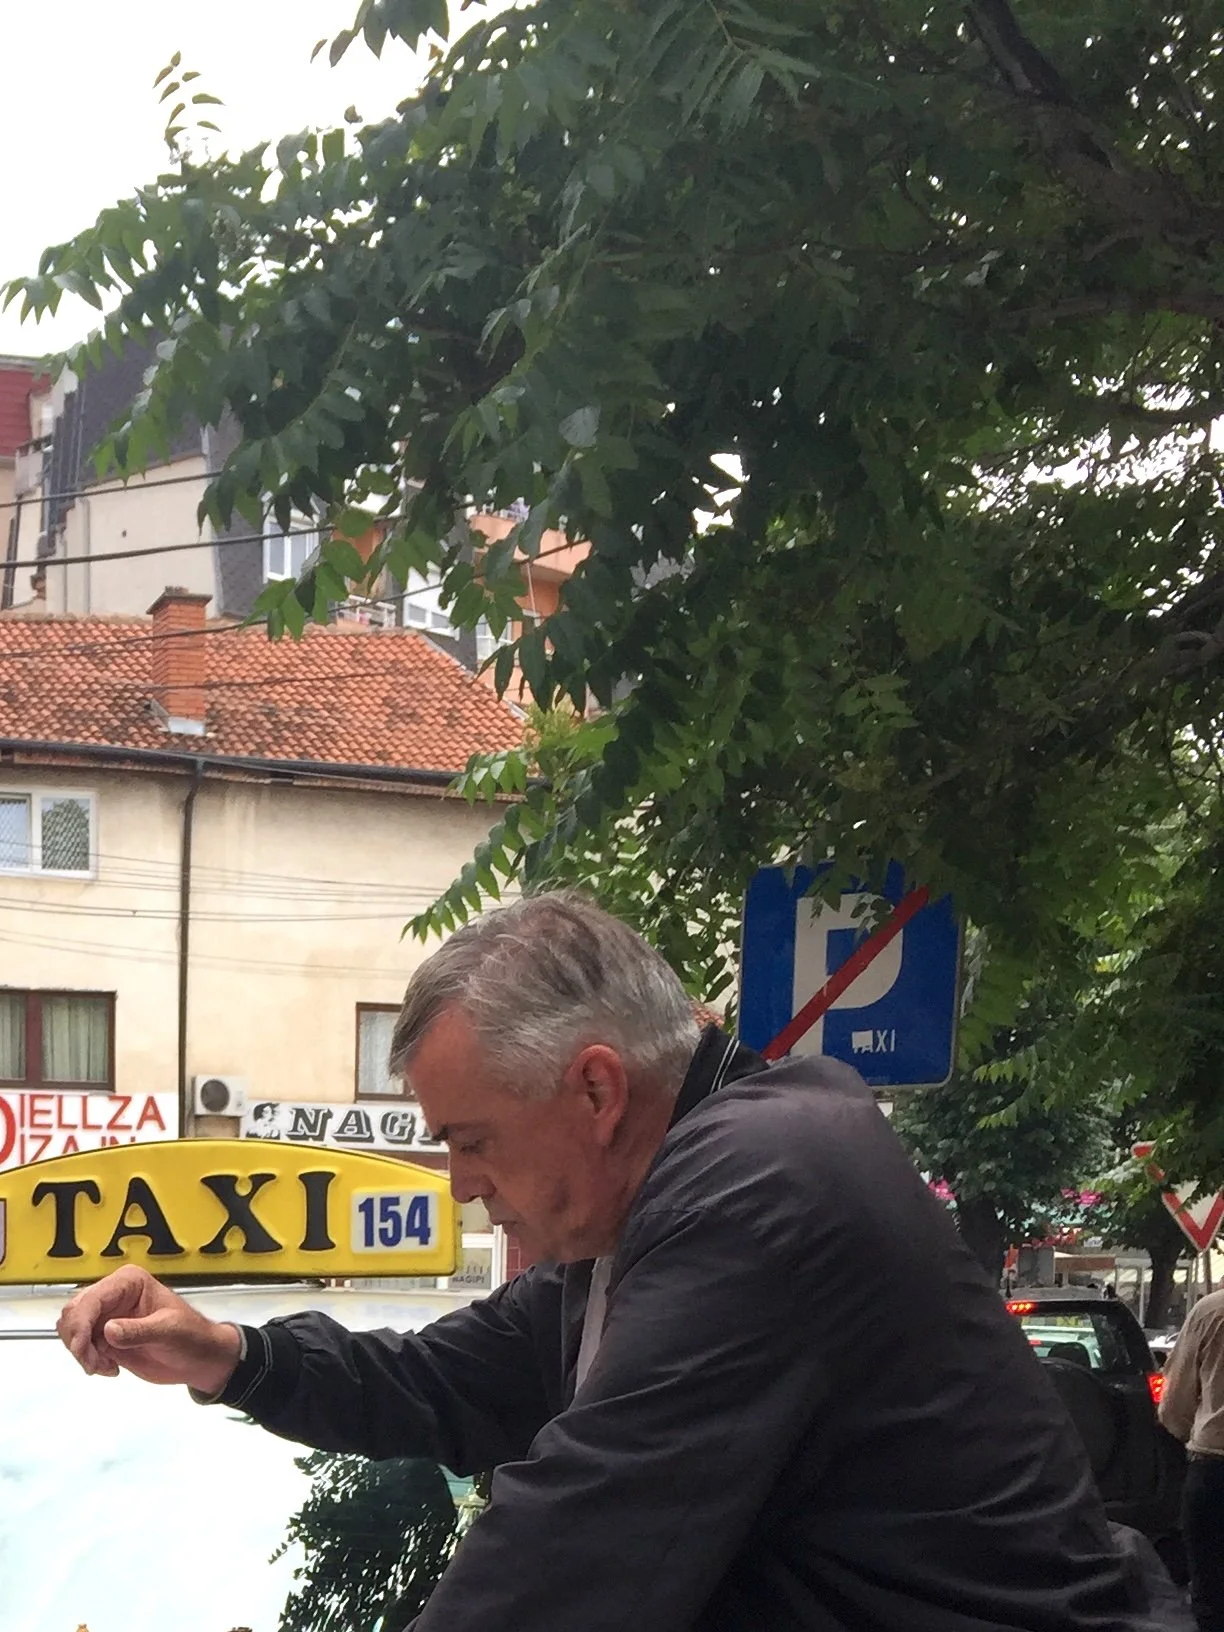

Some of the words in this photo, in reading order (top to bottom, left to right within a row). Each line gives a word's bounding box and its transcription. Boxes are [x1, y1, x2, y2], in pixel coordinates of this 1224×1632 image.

[851, 1029, 896, 1053] XI
[32, 1170, 337, 1258] TAXI
[358, 1195, 431, 1248] 154
